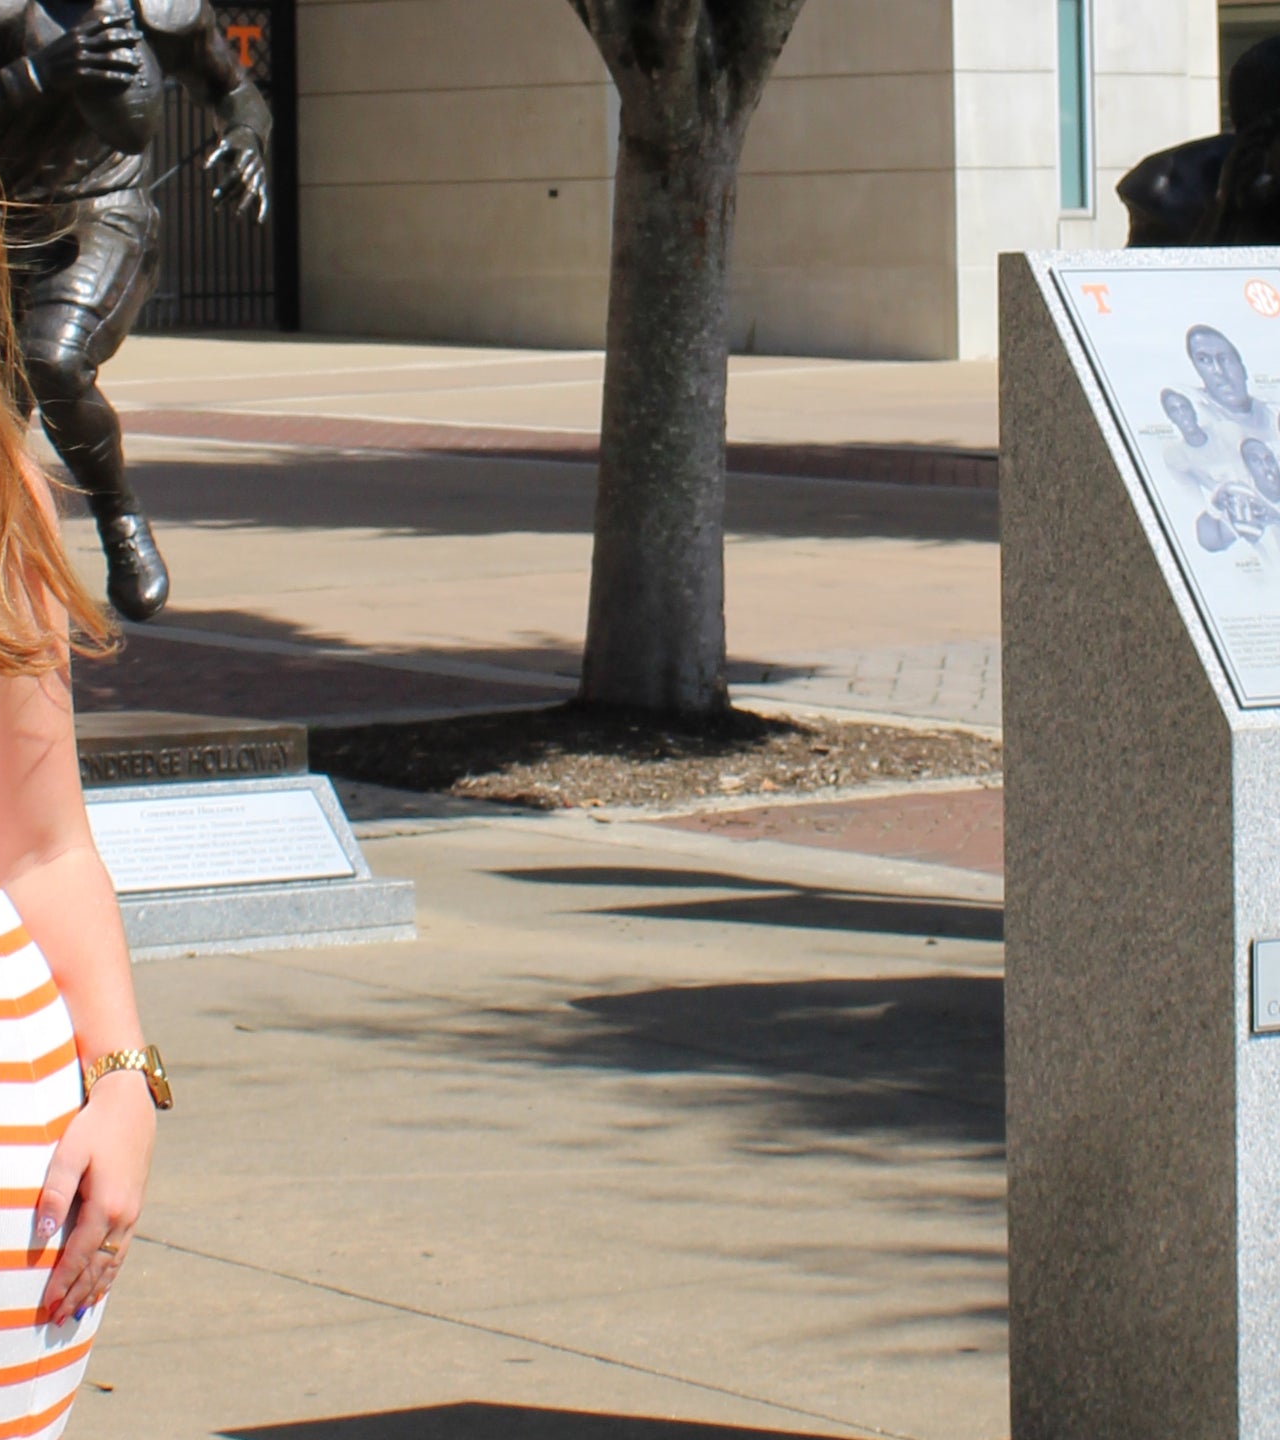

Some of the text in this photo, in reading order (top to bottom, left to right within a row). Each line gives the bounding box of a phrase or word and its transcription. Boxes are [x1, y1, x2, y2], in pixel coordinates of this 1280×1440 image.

[226, 24, 262, 67] T
[1080, 284, 1112, 314] T
[188, 740, 292, 773] HOLLOWAY
